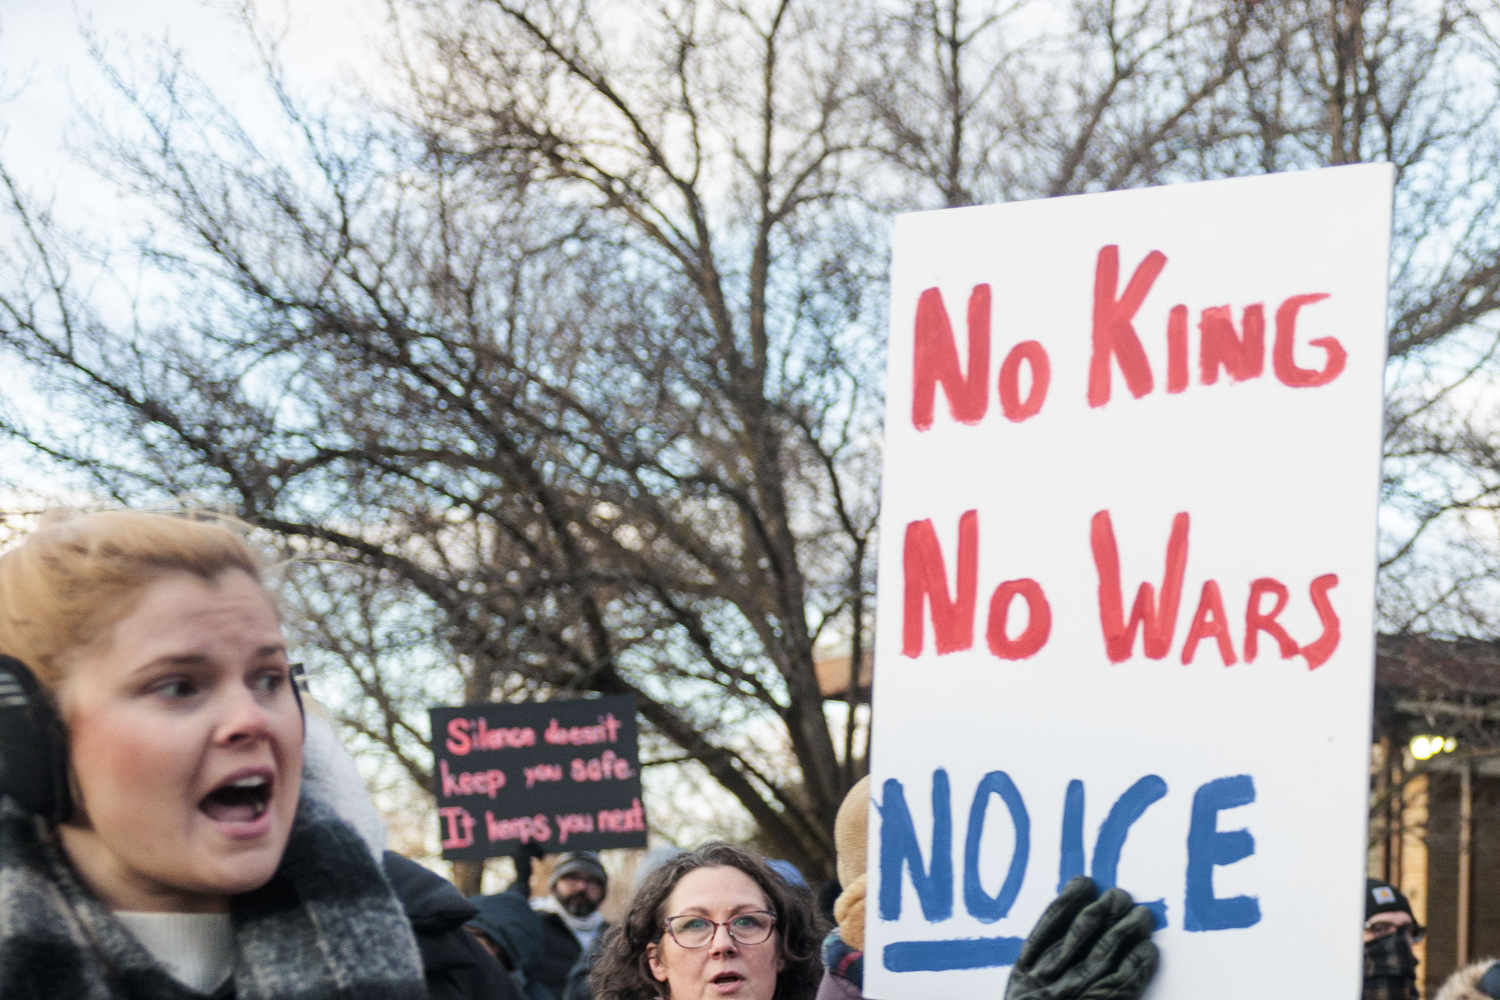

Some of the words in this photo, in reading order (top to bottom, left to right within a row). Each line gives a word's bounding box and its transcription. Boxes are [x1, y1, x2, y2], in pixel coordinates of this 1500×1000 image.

[911, 283, 1051, 432] No
[1086, 244, 1347, 408] KING
[901, 509, 1052, 661] No
[1090, 509, 1341, 671] WARS
[439, 759, 507, 798] keep
[523, 763, 563, 788] you
[445, 717, 536, 756] Silence
[484, 811, 552, 844] keeps
[555, 814, 594, 843] you
[875, 767, 1031, 923] NO
[1056, 774, 1262, 933] ICE
